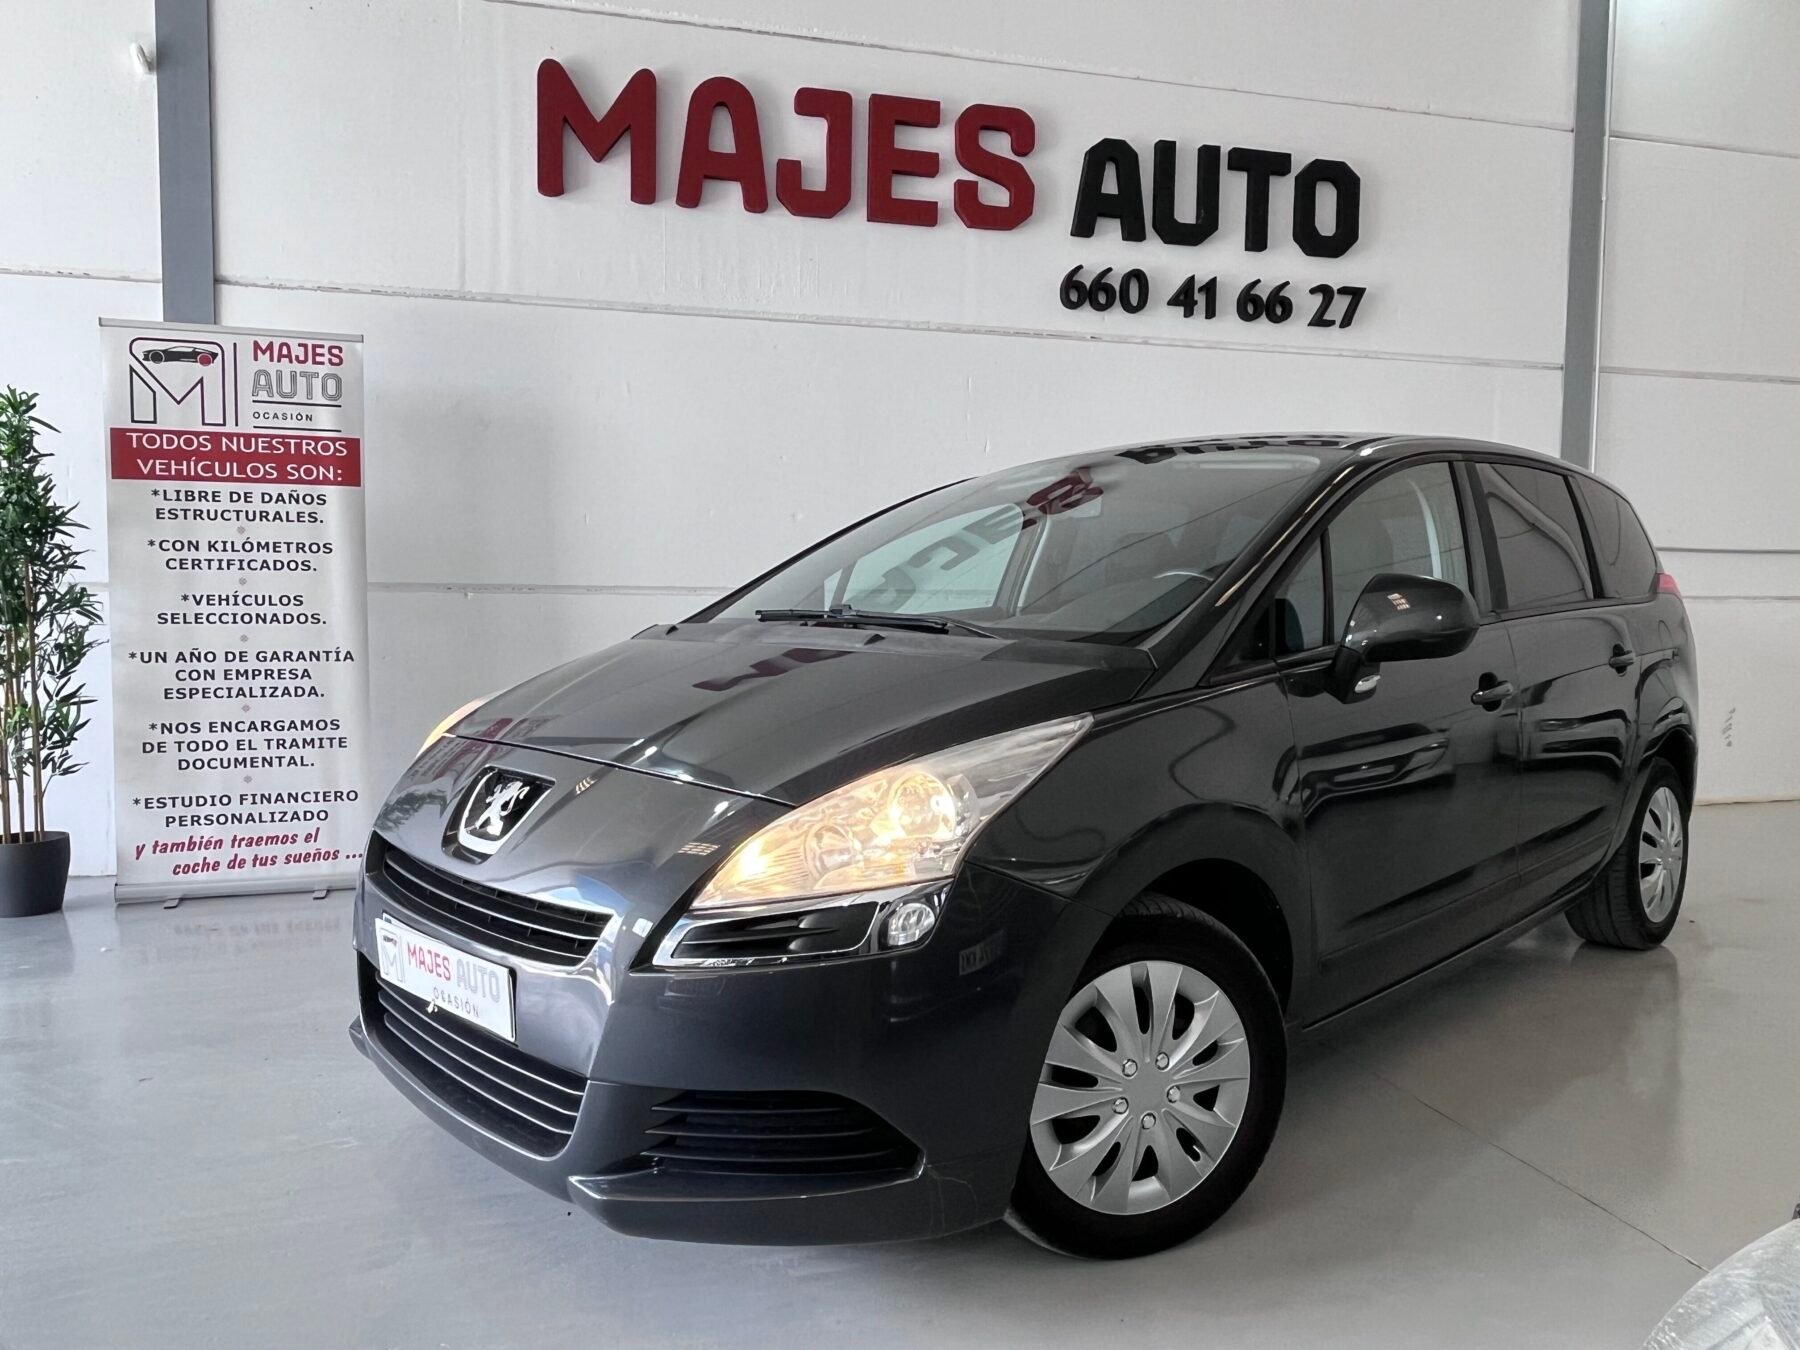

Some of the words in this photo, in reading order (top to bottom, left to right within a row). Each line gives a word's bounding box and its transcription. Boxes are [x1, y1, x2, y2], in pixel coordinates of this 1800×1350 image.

[537, 58, 1036, 231] MAJES
[1069, 137, 1362, 259] AUTO
[1060, 264, 1149, 315] 660
[1167, 276, 1218, 320] 41
[1236, 277, 1294, 324] 66
[1307, 283, 1368, 330] 27
[253, 340, 344, 367] MAJES
[251, 369, 343, 402] AUTO
[252, 411, 314, 422] OCASIÓN
[126, 432, 212, 452] TODOS
[222, 436, 348, 457] NUESTROS
[136, 457, 278, 480] VEHÍCULOS
[286, 464, 343, 481] SON:
[229, 491, 253, 504] DE
[260, 490, 328, 506] DAÑOS
[155, 508, 325, 524] ESTRUCTURALES.
[207, 537, 334, 555] KILÓMETROS
[165, 558, 318, 572] CERTIFICADOS.
[157, 612, 327, 626] SELECCIONADOS.
[175, 648, 217, 664] AÑO
[224, 651, 249, 664] DE
[255, 647, 355, 663] GARANTÍA
[175, 669, 216, 682] CON
[223, 668, 312, 681] EMPRESA
[164, 686, 325, 700] ESPECIALIZADA.
[208, 719, 341, 734] ENCARGAMOS
[142, 741, 167, 754] DE
[174, 740, 229, 753] TODO
[236, 739, 258, 751] EL
[264, 736, 348, 751] TRAMITE
[178, 756, 315, 771] DOCUMENTAL.
[239, 790, 359, 806] FINANCIERO
[165, 809, 329, 828] PERSONALIZADO
[135, 842, 146, 860] y
[152, 835, 224, 856] también
[230, 832, 298, 849] traemos
[304, 827, 320, 844] el
[172, 855, 220, 876] coche
[227, 853, 247, 870] de
[252, 854, 277, 868] tus
[284, 847, 340, 866] sueños
[406, 941, 452, 981] MAJES
[456, 957, 500, 1003] AUTO
